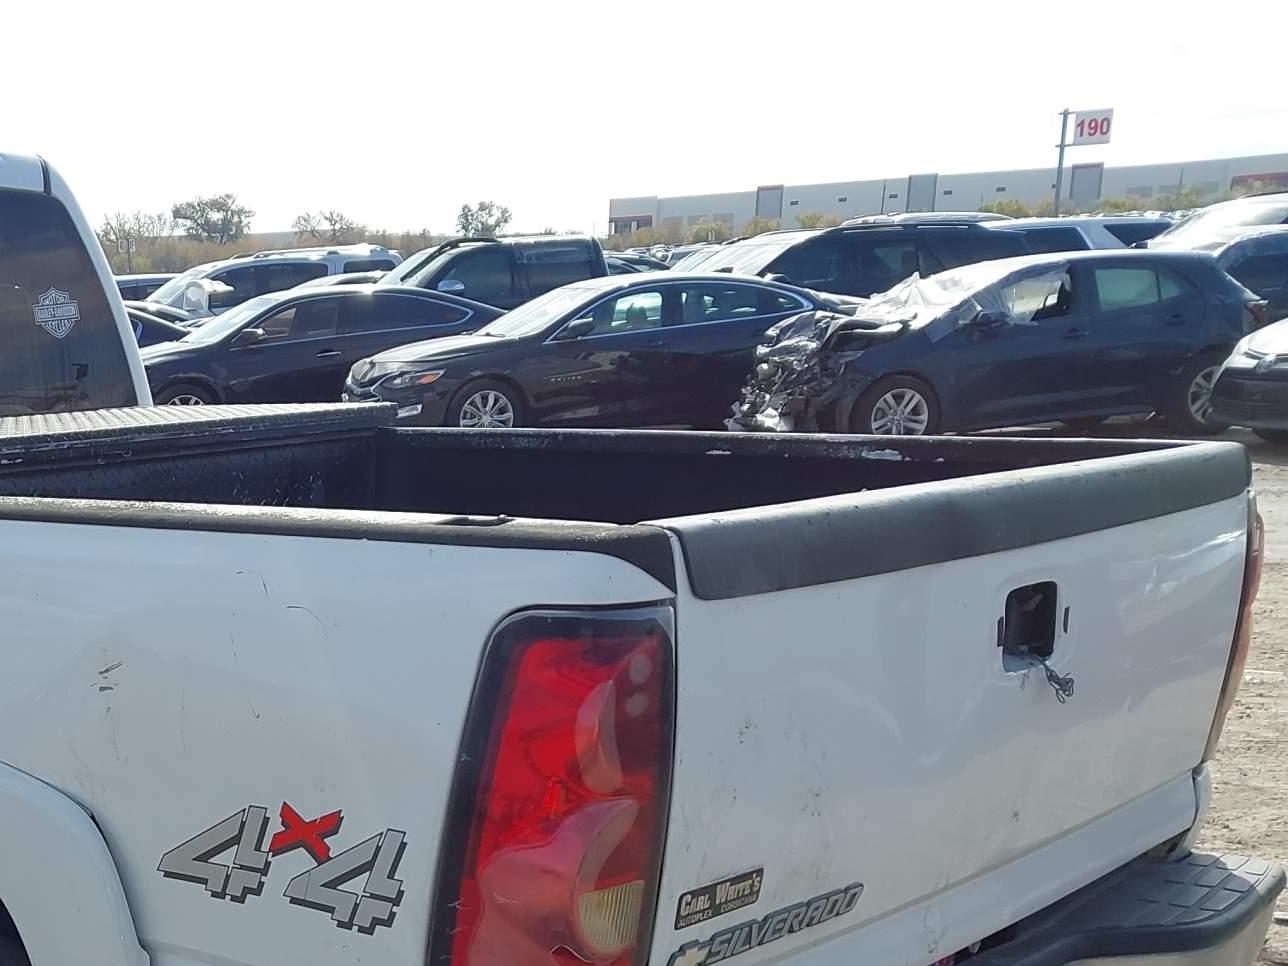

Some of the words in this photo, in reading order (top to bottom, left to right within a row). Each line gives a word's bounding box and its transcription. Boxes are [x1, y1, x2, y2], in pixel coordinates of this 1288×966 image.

[1076, 117, 1111, 137] 190
[680, 893, 711, 916] CARL
[715, 873, 761, 905] WHITE'S
[707, 883, 864, 963] SILVERADO
